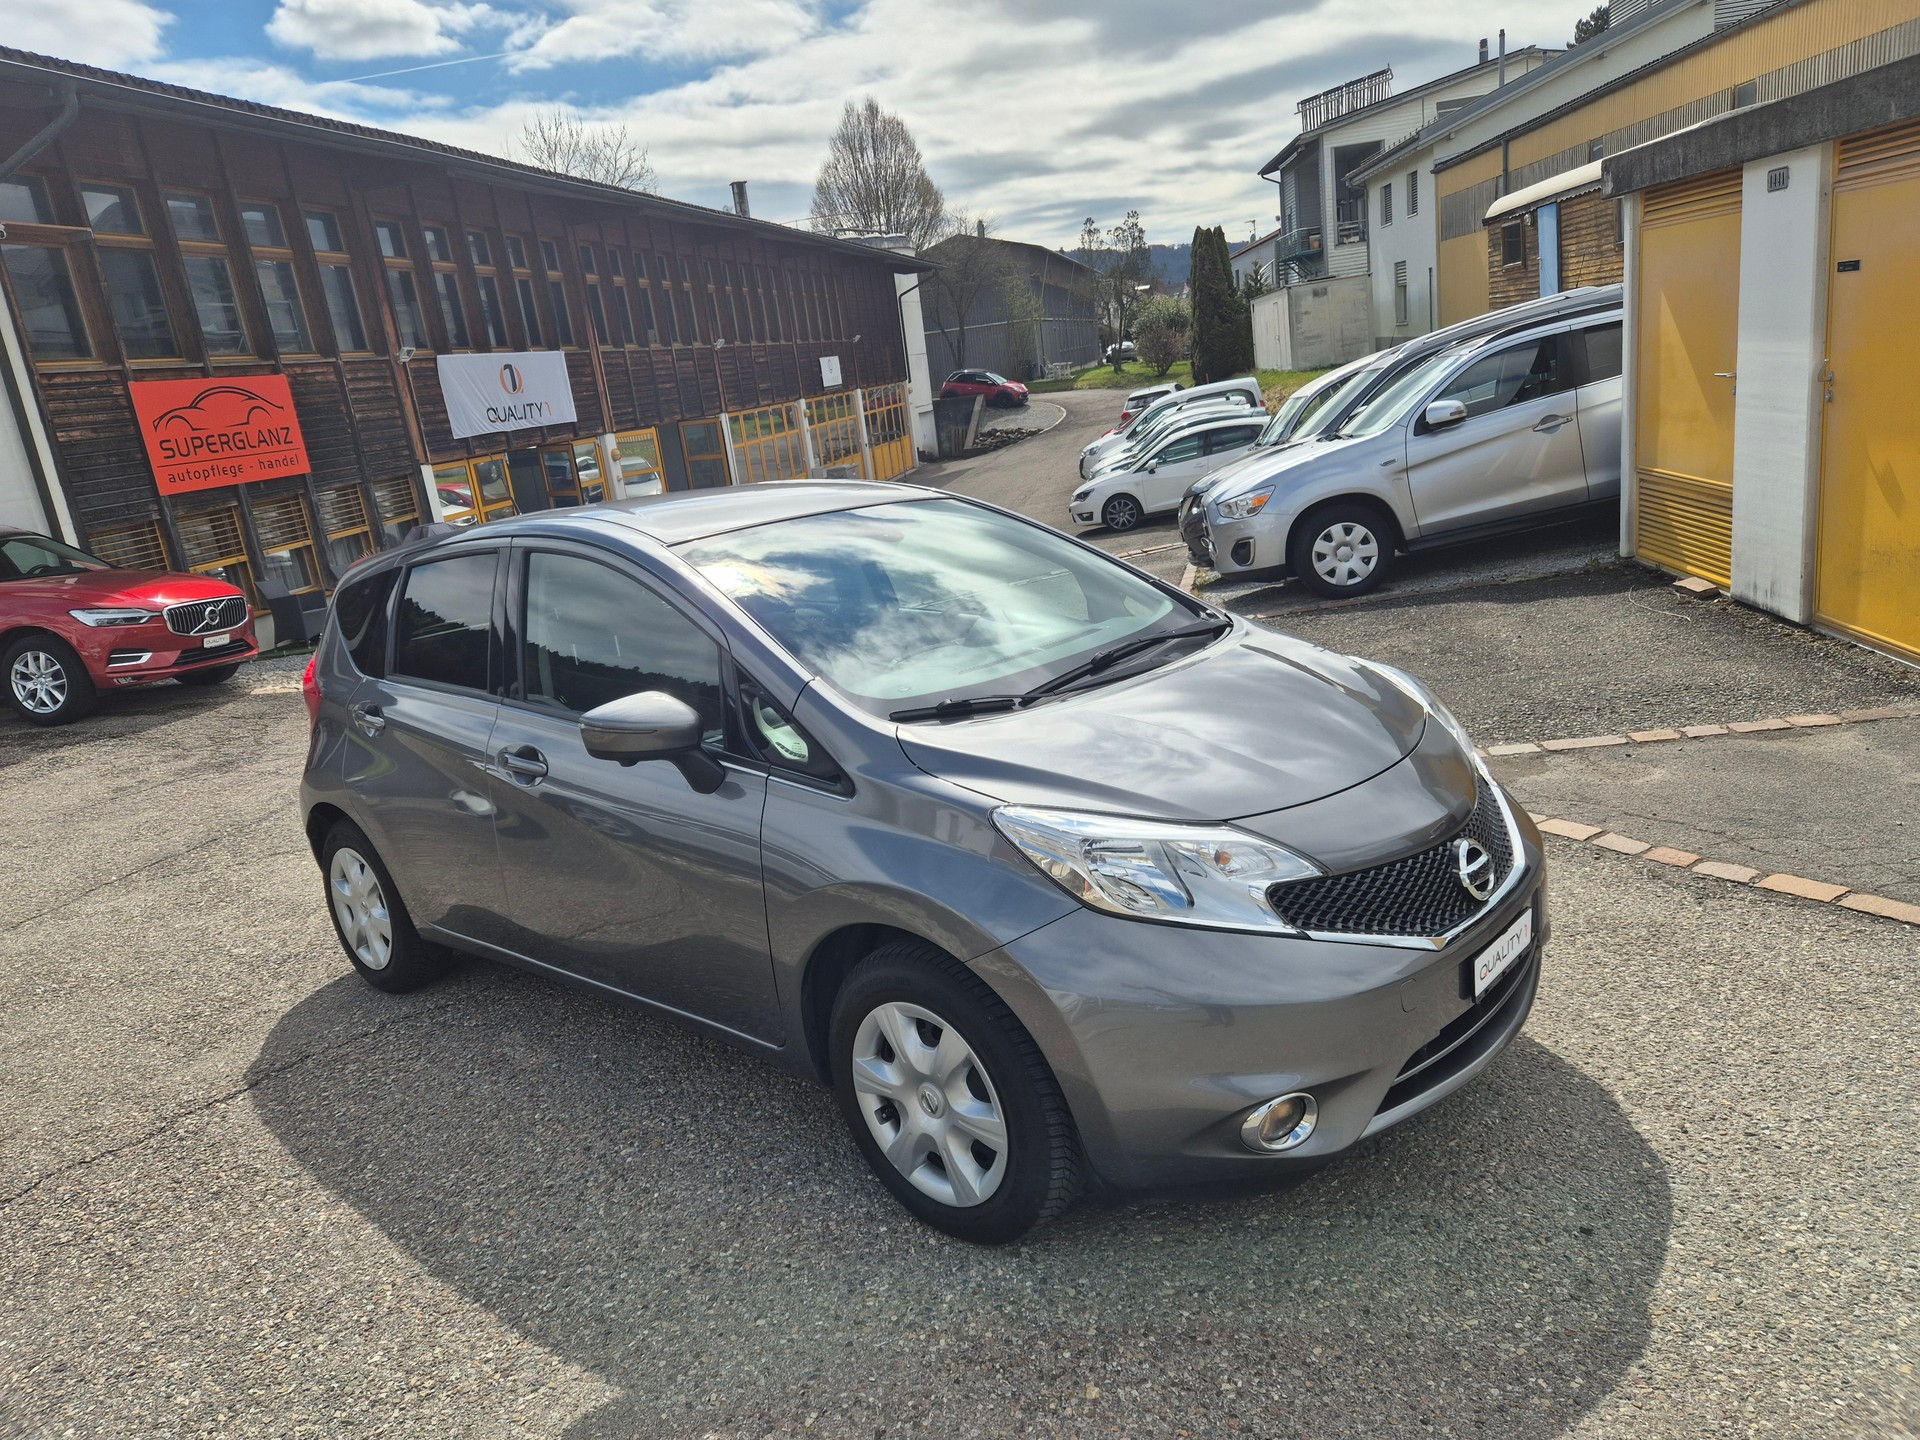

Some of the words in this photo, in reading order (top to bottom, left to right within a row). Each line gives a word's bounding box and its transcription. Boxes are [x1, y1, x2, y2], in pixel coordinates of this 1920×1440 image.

[1770, 171, 1785, 188] 1441
[159, 426, 294, 460] SUPERGLANZ
[168, 463, 245, 484] autopflege
[257, 454, 300, 471] handel
